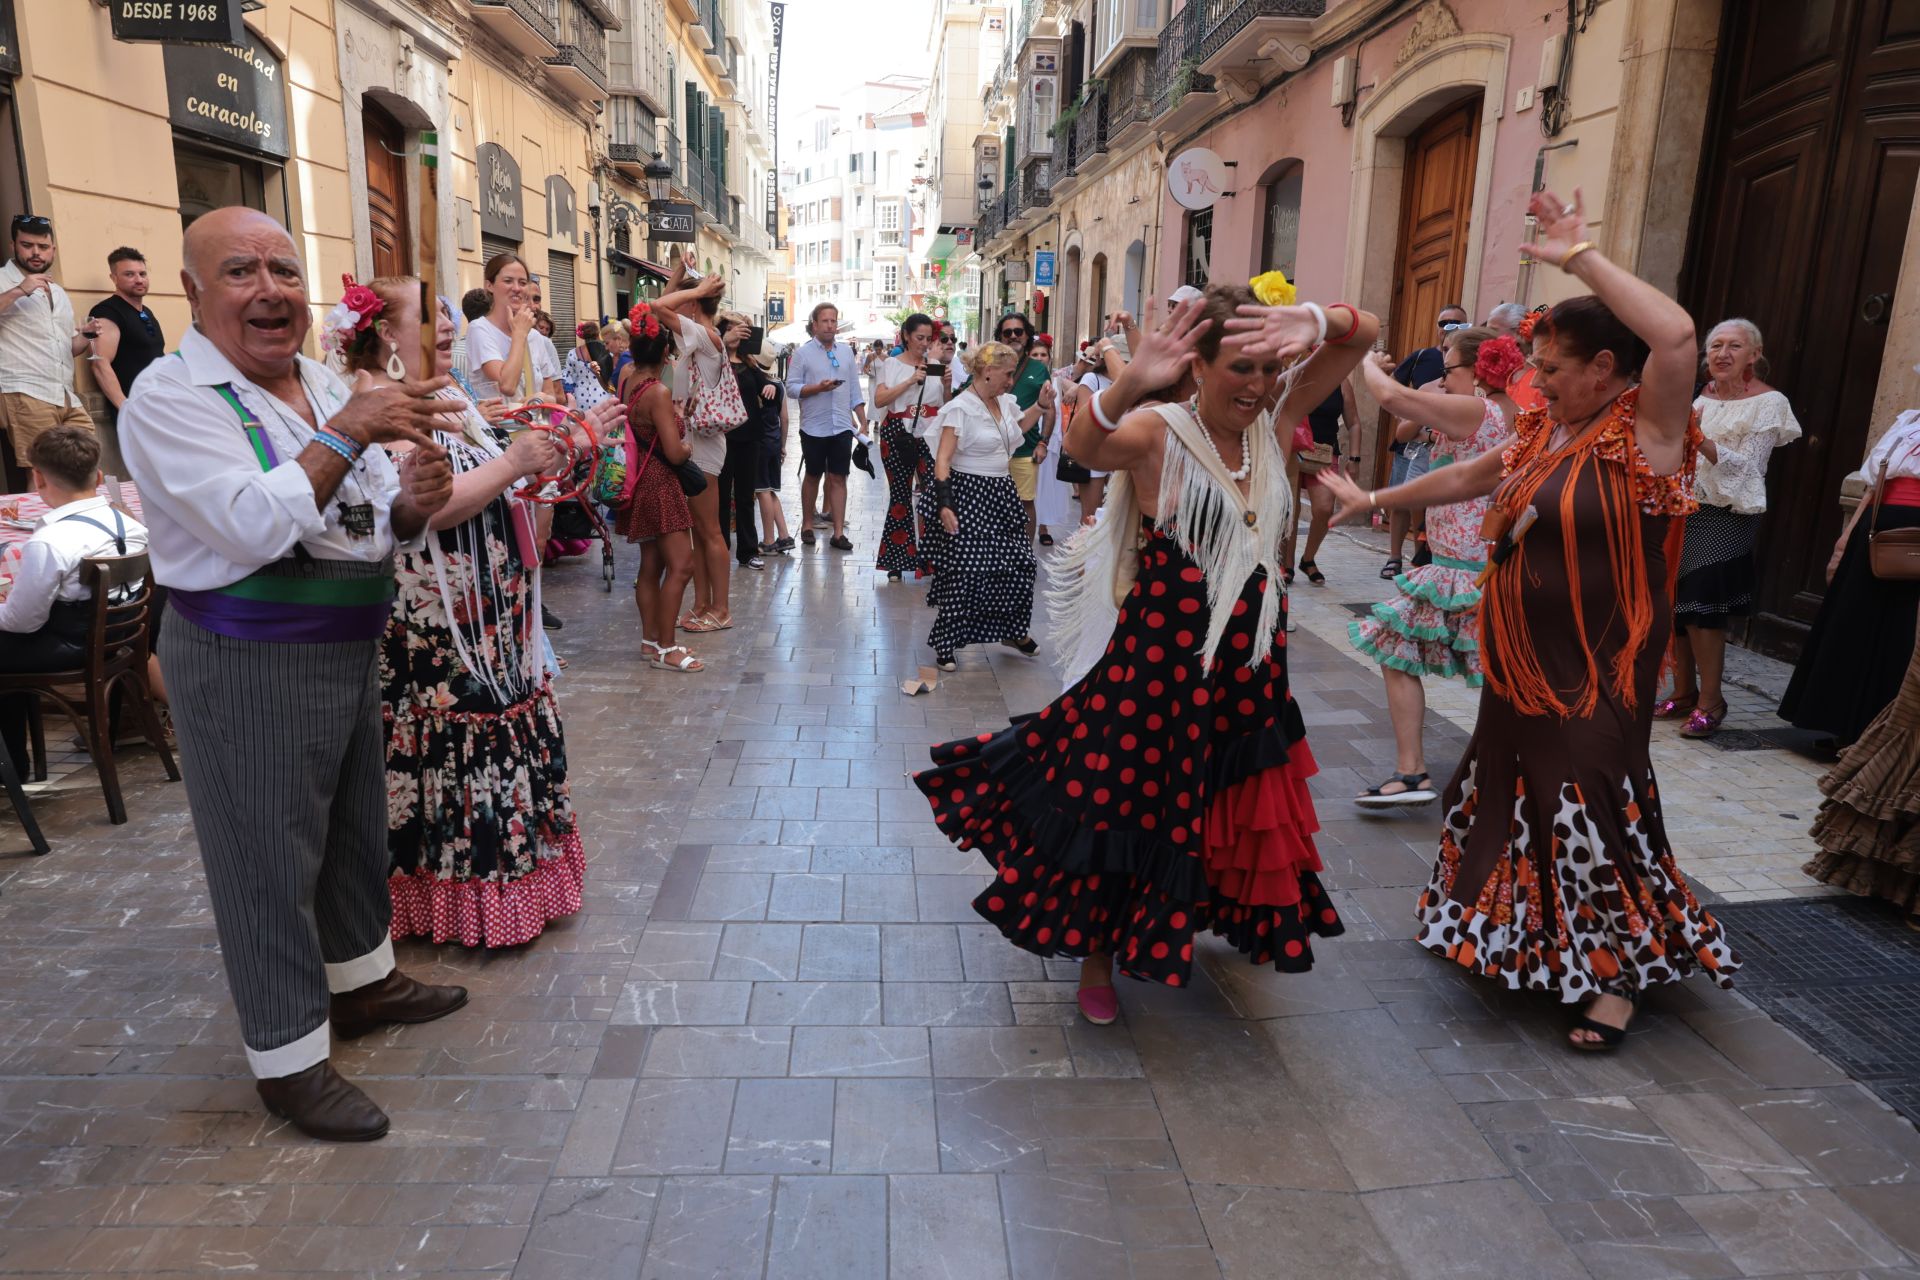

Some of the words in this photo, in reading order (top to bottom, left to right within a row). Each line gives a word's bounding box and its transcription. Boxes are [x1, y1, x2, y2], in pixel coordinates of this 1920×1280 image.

[122, 2, 172, 20] DESDE
[178, 4, 217, 22] 1968
[217, 72, 239, 92] en
[186, 96, 271, 138] caracoles
[767, 171, 776, 211] MUSEO
[773, 6, 782, 35] OXO
[771, 300, 781, 312] T
